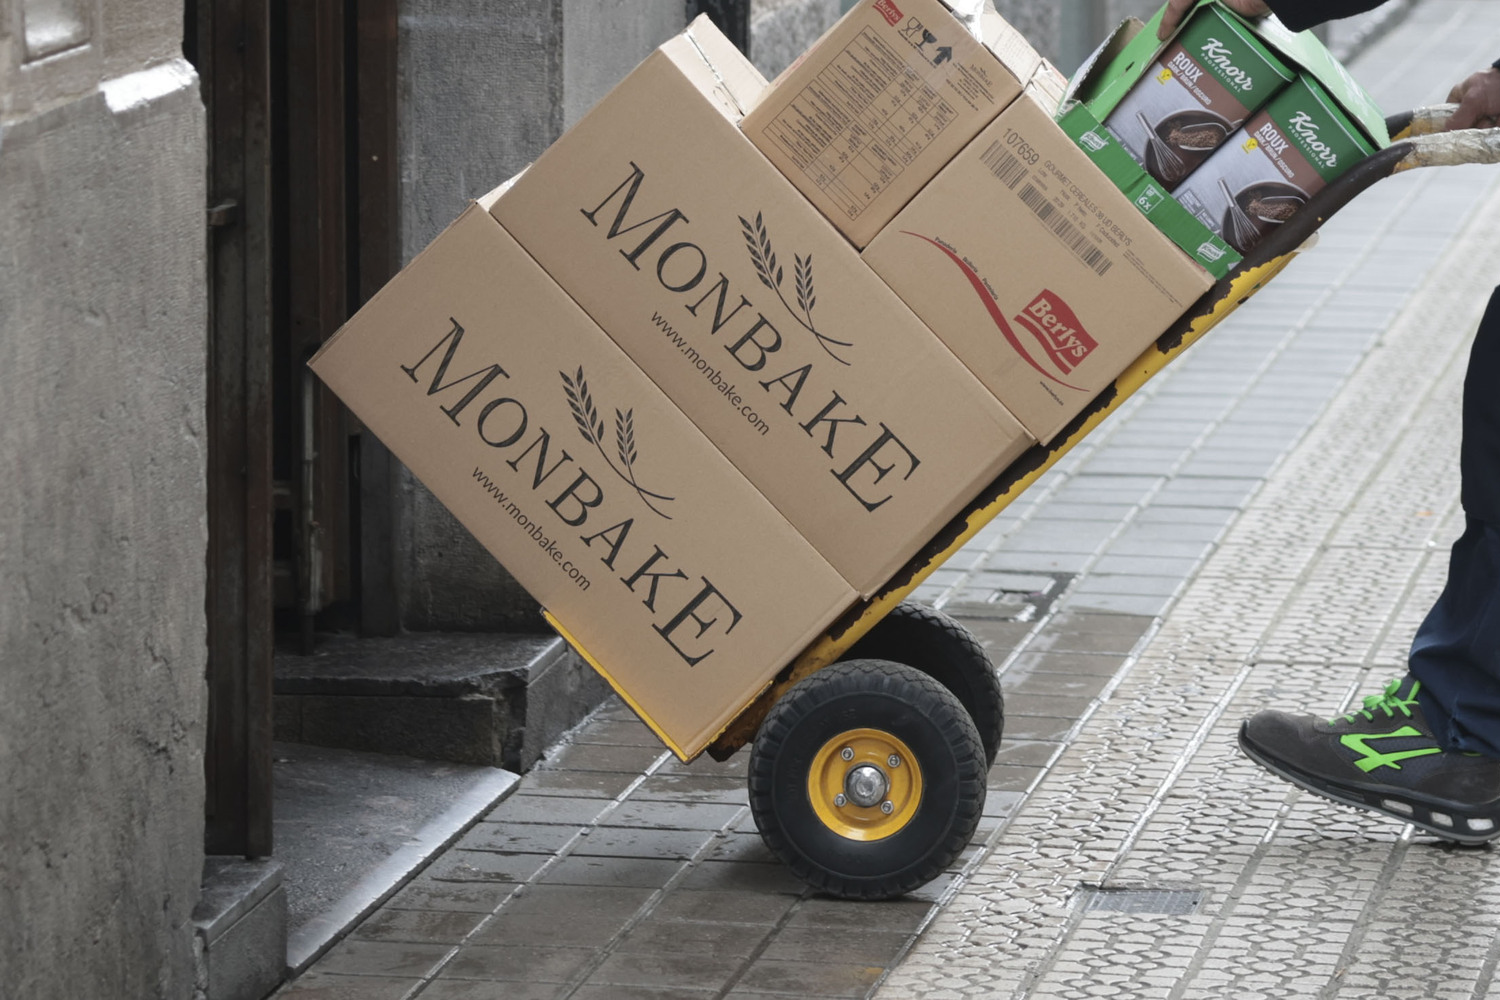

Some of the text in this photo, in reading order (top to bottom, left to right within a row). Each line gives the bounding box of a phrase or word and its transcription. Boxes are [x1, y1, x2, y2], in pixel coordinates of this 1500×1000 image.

[1172, 51, 1203, 82] ROUX
[1200, 37, 1254, 92] Knorr
[1201, 51, 1241, 92] PROFESSIONAL
[1003, 127, 1040, 166] 107659
[1259, 121, 1289, 154] ROUX
[1286, 124, 1325, 168] PROFESSIONAL
[1288, 110, 1339, 169] Knorr
[1043, 159, 1072, 188] GOURMET
[1068, 184, 1098, 213] CEREALES
[1094, 209, 1105, 220] 38
[1101, 216, 1112, 228] UD
[1109, 224, 1132, 247] BERLYS
[1137, 196, 1152, 210] 6x
[580, 161, 921, 512] MONBAKE
[1027, 297, 1088, 360] Berlys
[650, 309, 770, 436] www.monbake.com
[400, 317, 742, 667] MONBAKE
[472, 465, 590, 591] www.monbake.com
